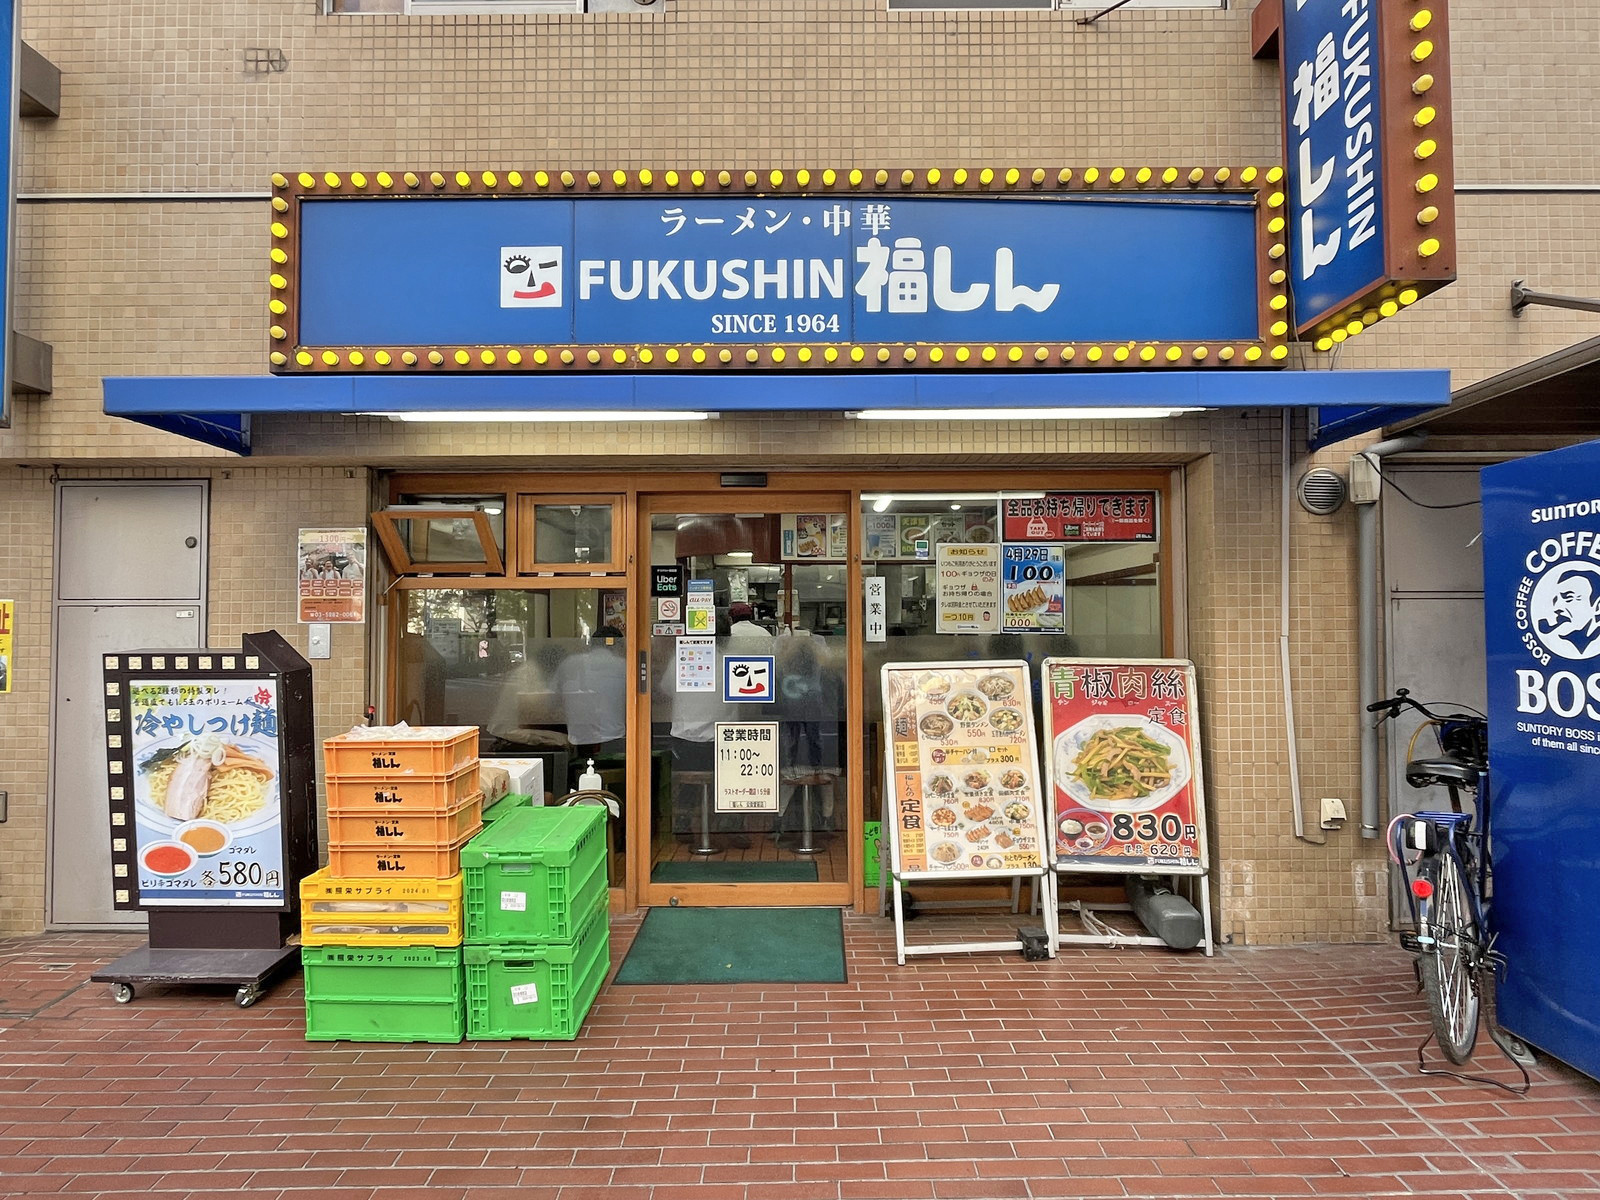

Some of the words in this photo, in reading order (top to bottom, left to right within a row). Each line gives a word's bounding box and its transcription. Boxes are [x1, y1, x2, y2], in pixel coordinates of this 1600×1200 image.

[1293, 32, 1341, 281] 福しん
[660, 204, 892, 236] ラーメン・中華
[578, 258, 844, 300] FUKUSHIN
[854, 237, 1061, 313] 福しん
[711, 314, 776, 333] SINCE
[785, 314, 840, 333] 1964
[1007, 496, 1150, 517] 全品お持ち帰りできます
[656, 575, 677, 583] Uber
[656, 583, 677, 591] Eats
[869, 583, 882, 635] 営業中
[1516, 576, 1533, 630] COFFEE
[1050, 668, 1185, 699] 青椒肉絲
[135, 708, 277, 737] 冷やしつけ麺
[1148, 707, 1186, 725] 定食
[723, 728, 771, 741] 営業時間
[1517, 722, 1563, 737] SUNTORY
[1565, 727, 1595, 741] BOSS
[1532, 737, 1541, 745] of
[1542, 738, 1565, 749] them
[1566, 742, 1577, 751] all
[740, 764, 774, 776] 22:00
[901, 799, 921, 830] 定食
[1113, 814, 1196, 842] 830円
[229, 845, 257, 854] ゴマダレ
[1150, 845, 1191, 856] 620円
